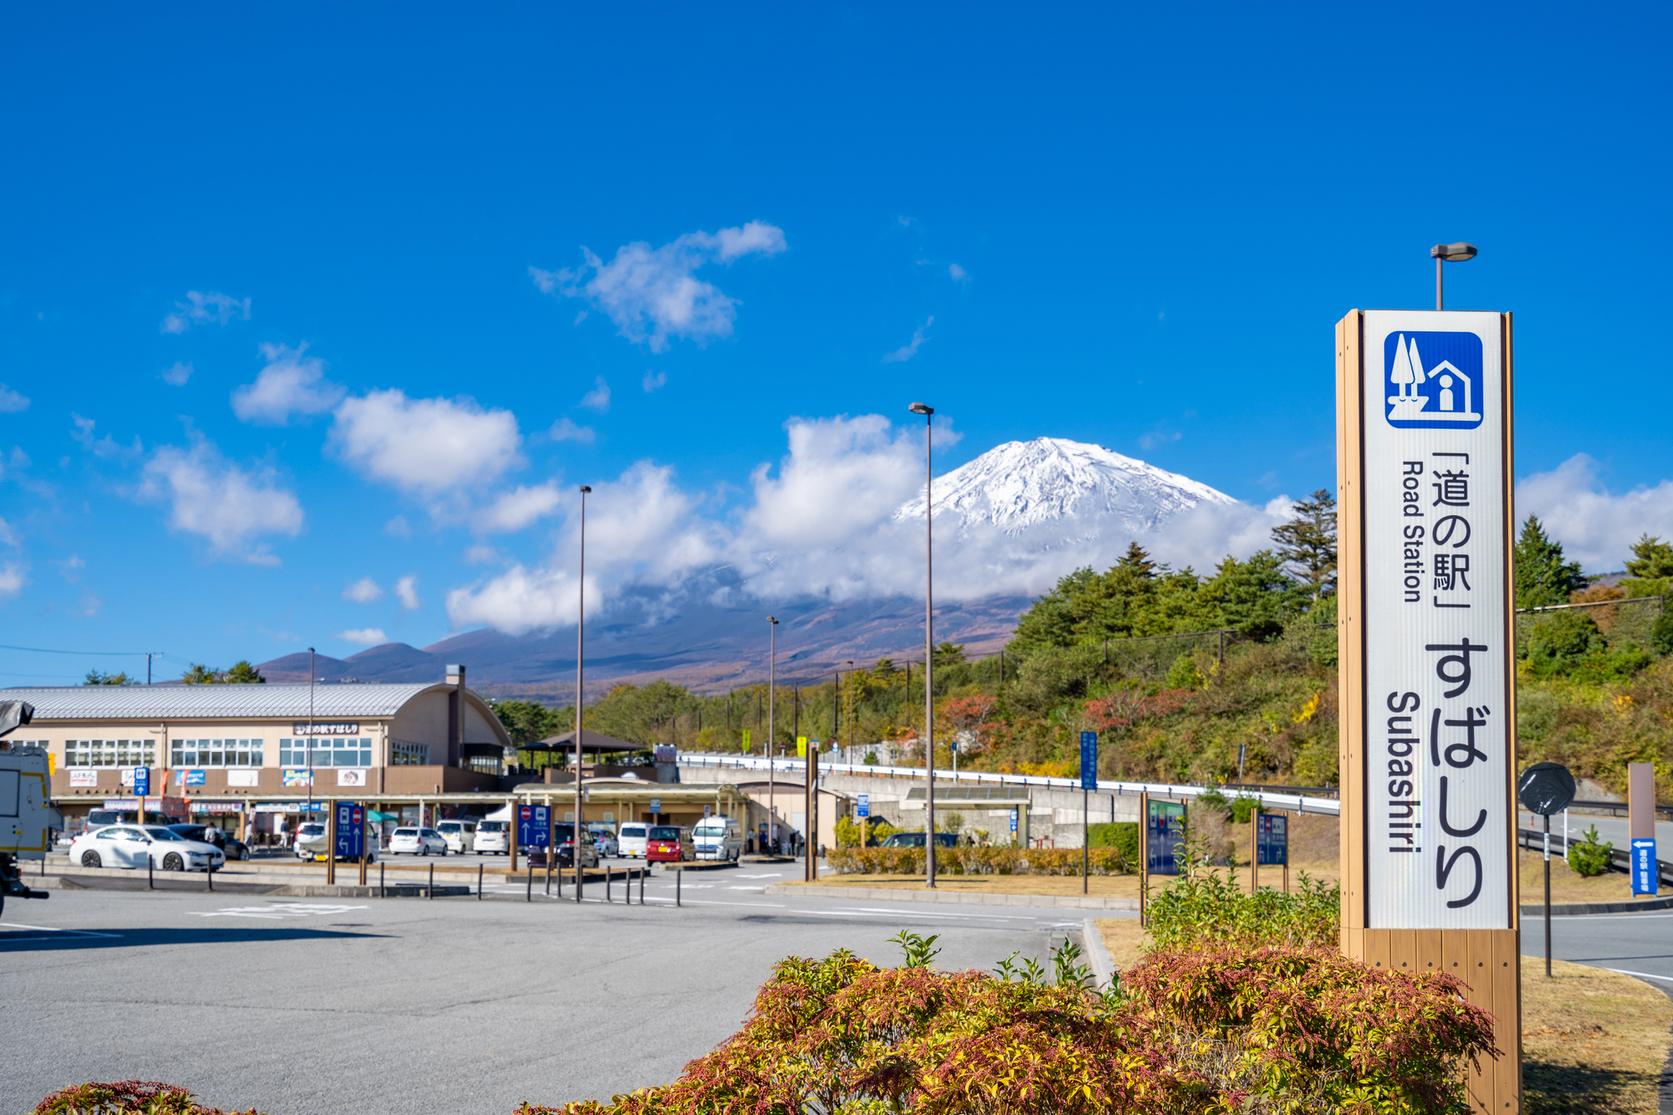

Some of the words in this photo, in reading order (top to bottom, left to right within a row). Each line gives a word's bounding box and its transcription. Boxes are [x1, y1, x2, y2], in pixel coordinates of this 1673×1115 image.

[1402, 461, 1425, 517] Road
[1403, 525, 1426, 603] Station
[1431, 452, 1472, 609] 「道の駅」
[1386, 691, 1422, 853] Subashiri
[1424, 637, 1491, 909] すばしり
